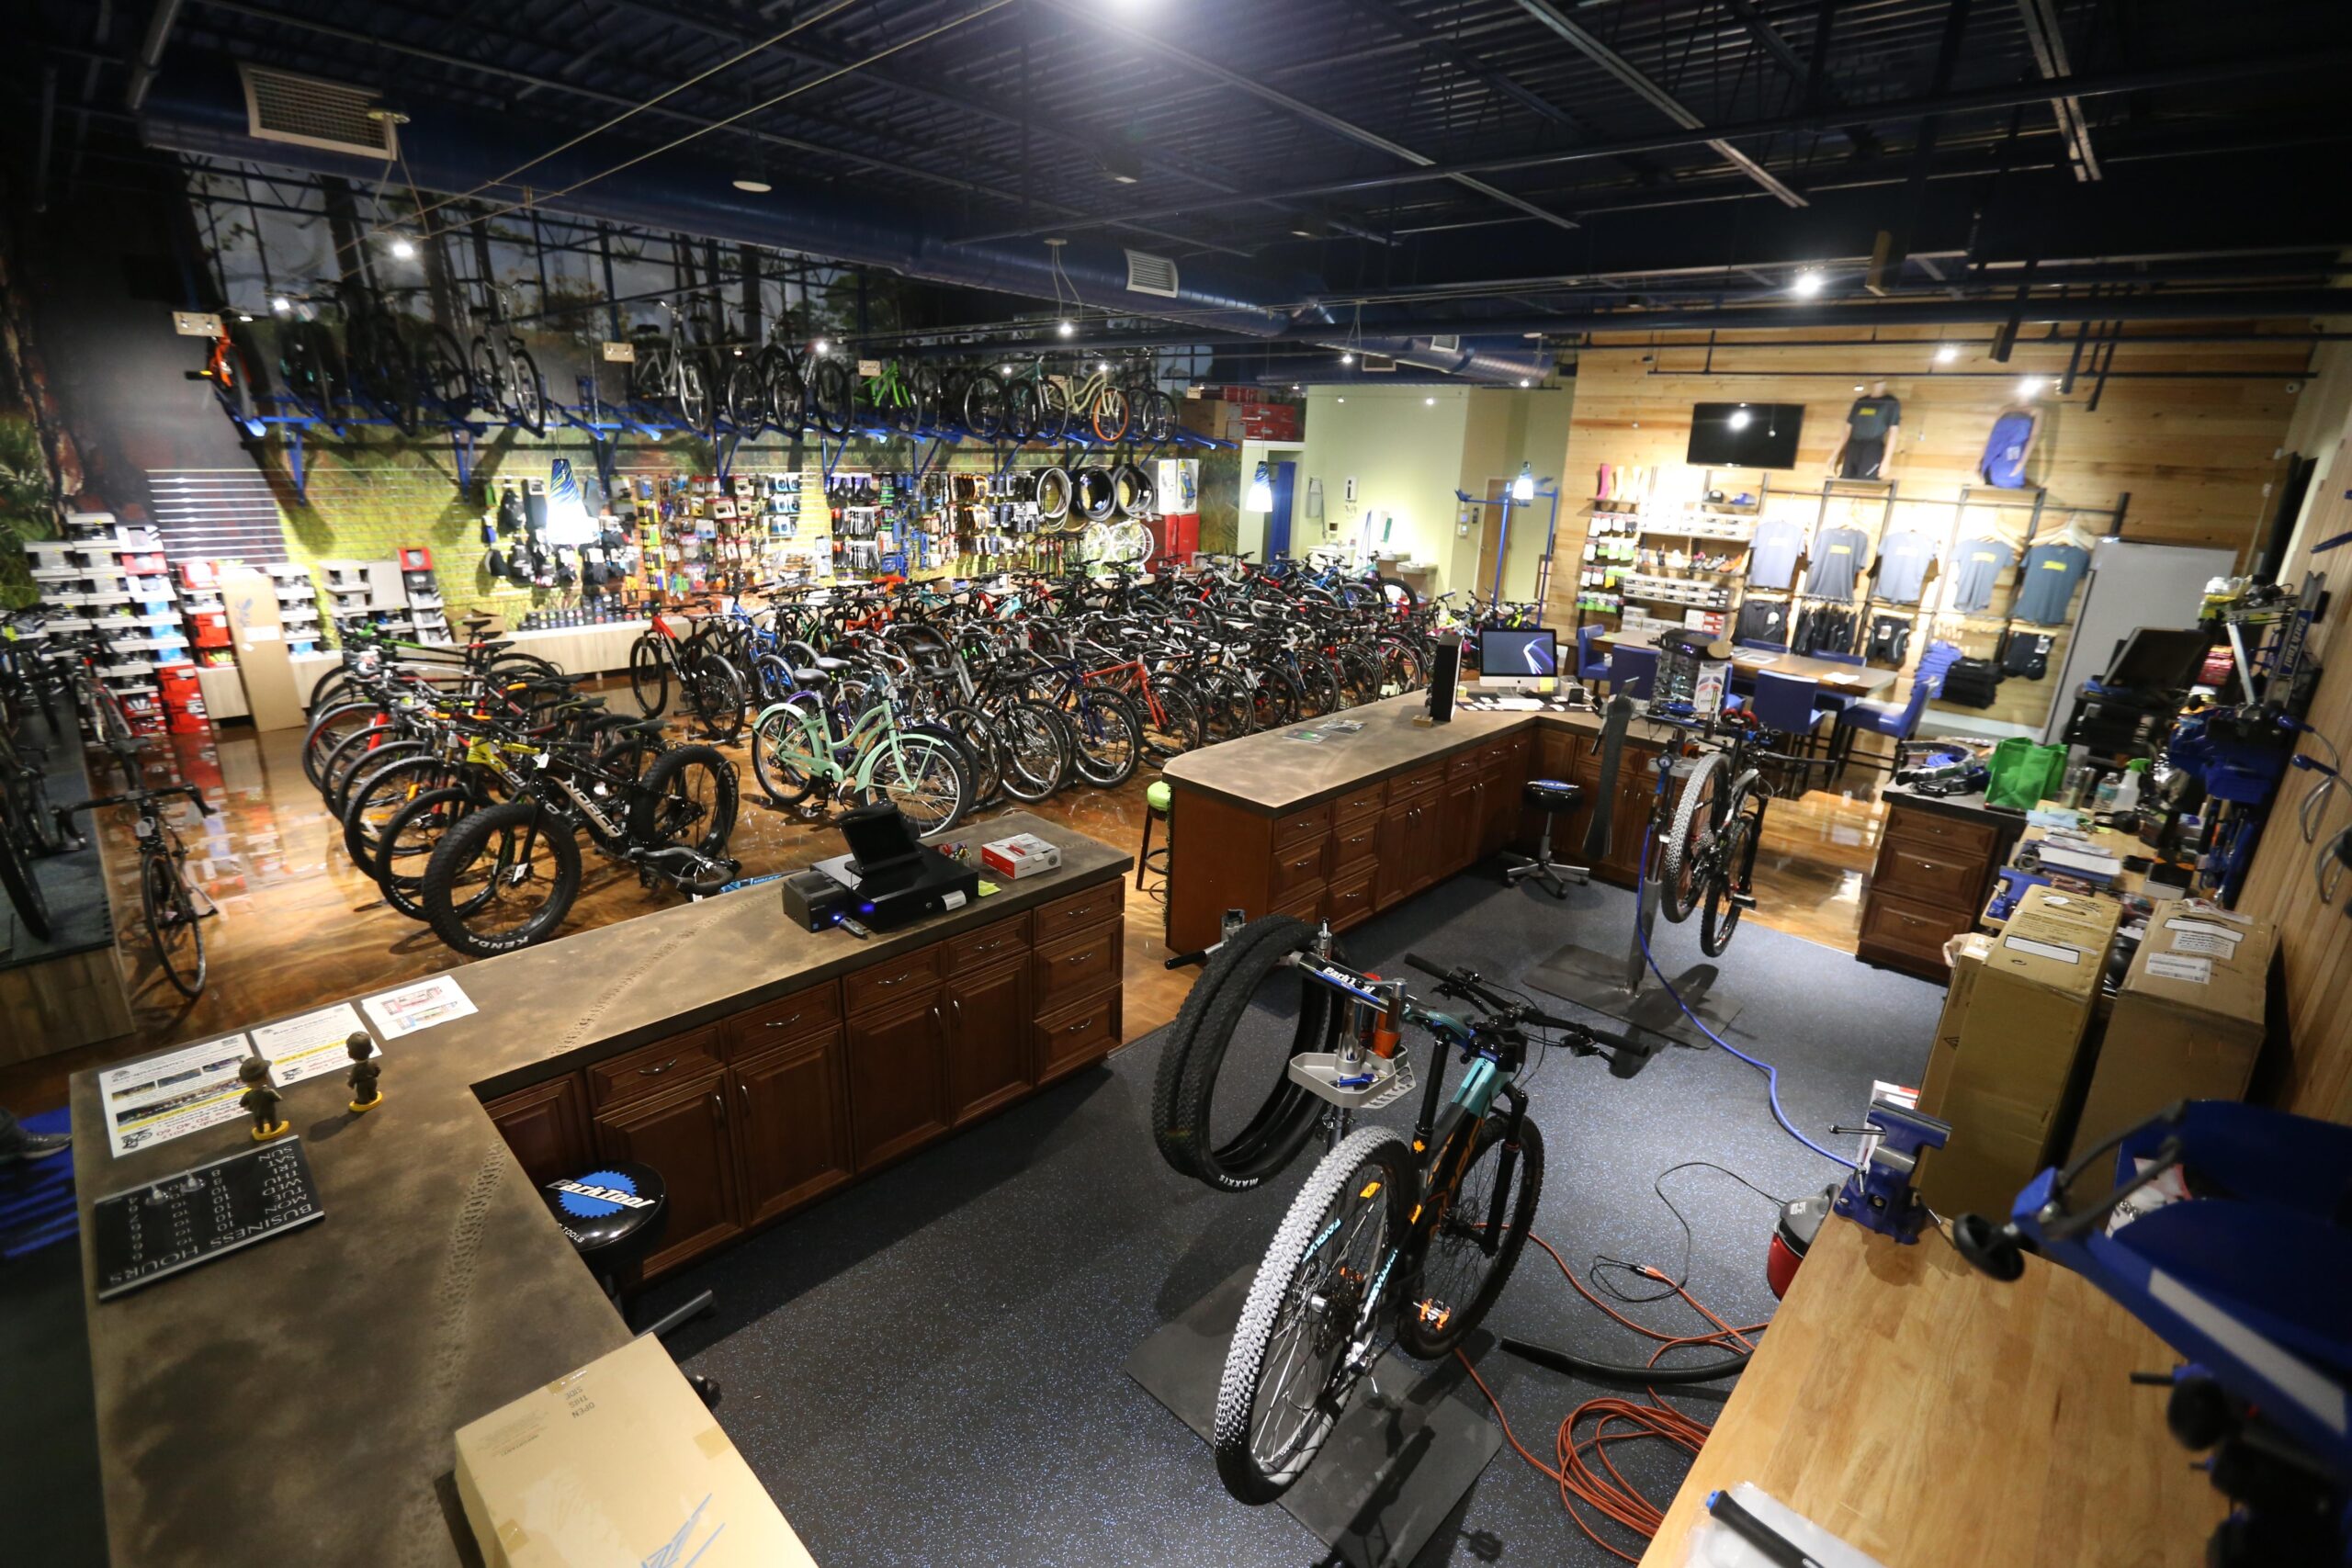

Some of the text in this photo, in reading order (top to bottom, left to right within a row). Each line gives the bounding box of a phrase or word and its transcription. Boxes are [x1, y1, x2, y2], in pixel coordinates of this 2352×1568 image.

[467, 934, 529, 951] KENDA
[258, 1145, 293, 1162] SUN
[266, 1153, 295, 1168] SAT
[211, 1168, 221, 1178] 8
[273, 1160, 298, 1175] FRI
[213, 1177, 222, 1186] 8
[264, 1169, 300, 1188] THU
[1218, 1174, 1259, 1188] MAXXIS
[211, 1184, 228, 1196] 10
[262, 1178, 302, 1196] WED
[275, 1186, 306, 1201] TUE
[212, 1193, 231, 1205] 10
[264, 1193, 308, 1214] MON
[214, 1202, 232, 1214] 10
[215, 1212, 233, 1224] 10
[217, 1220, 235, 1232] 10
[561, 1226, 586, 1244] TOOLS
[109, 1203, 312, 1285] BUSINESS HOURS
[571, 1402, 595, 1419] OPEN
